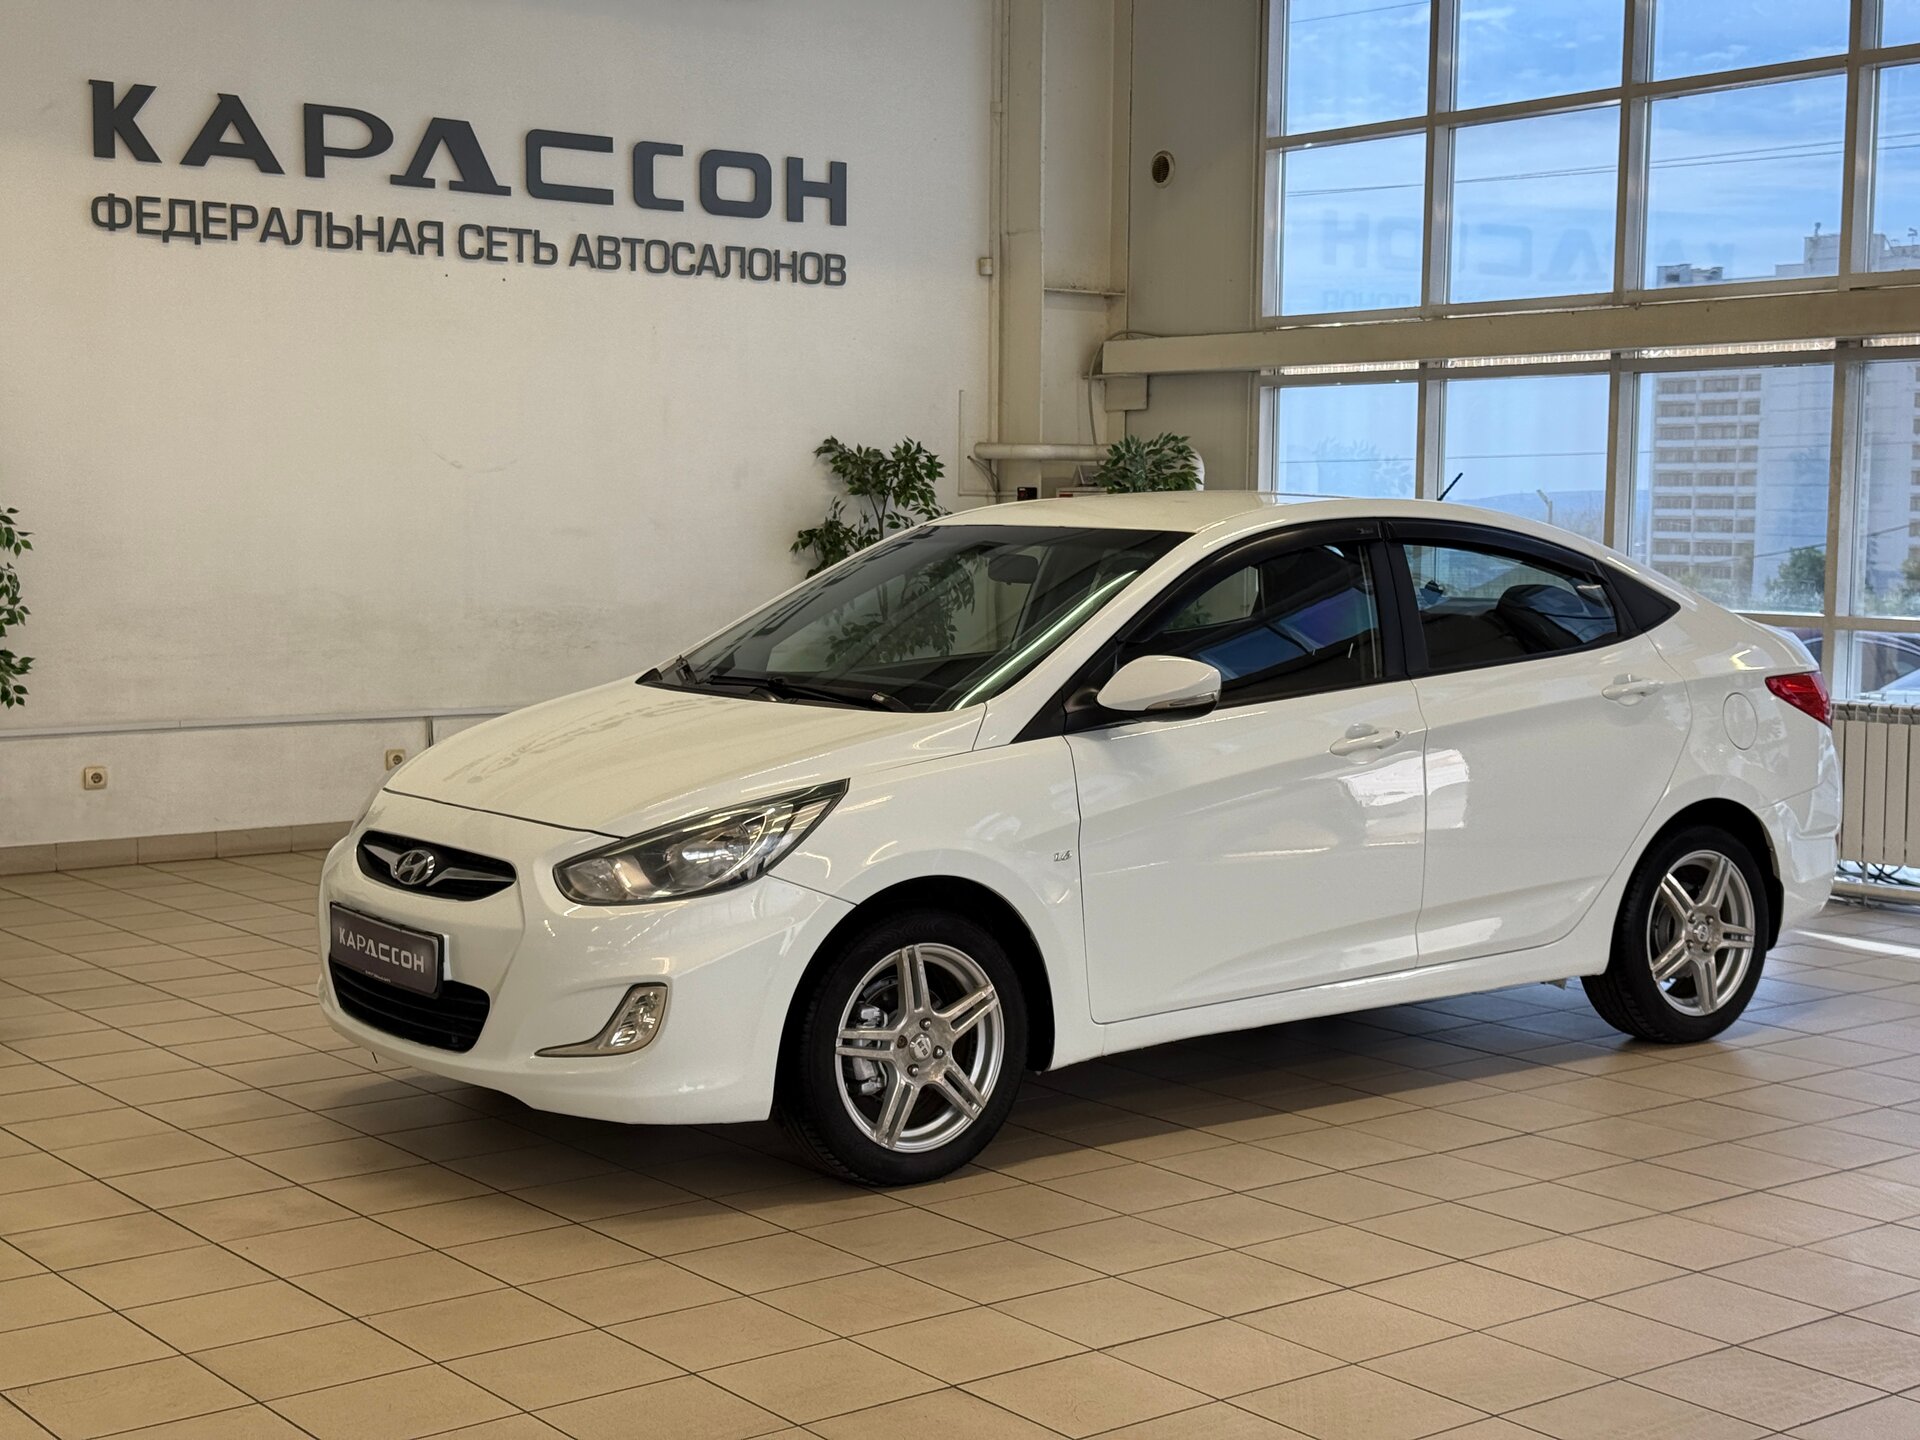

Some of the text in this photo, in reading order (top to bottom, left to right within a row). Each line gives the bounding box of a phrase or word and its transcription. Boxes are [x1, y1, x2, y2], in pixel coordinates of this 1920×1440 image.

[91, 193, 847, 287] ФЕДЕРАЛЬНАЯ СЕТЬ АВТОСАЛОНОВ
